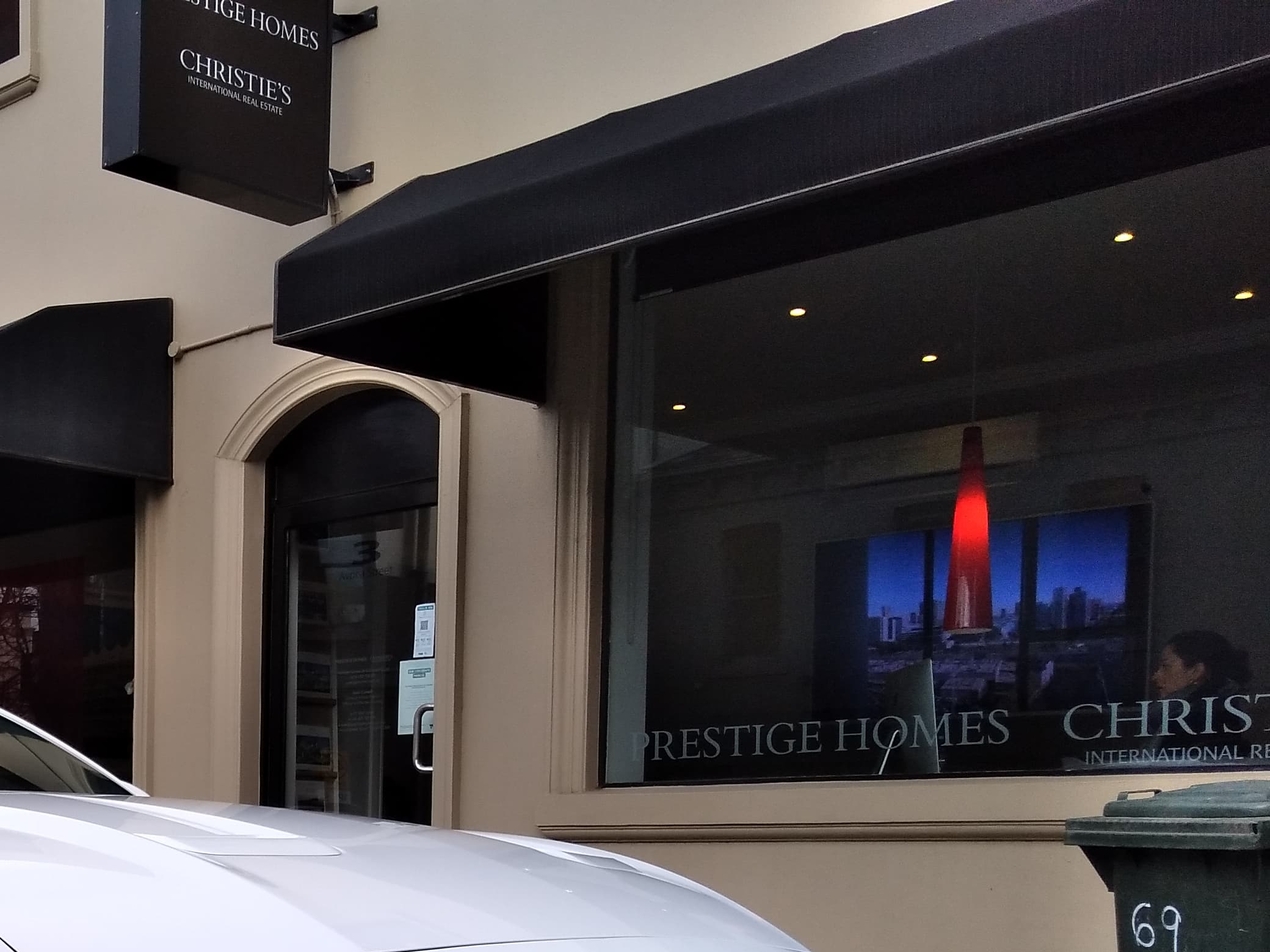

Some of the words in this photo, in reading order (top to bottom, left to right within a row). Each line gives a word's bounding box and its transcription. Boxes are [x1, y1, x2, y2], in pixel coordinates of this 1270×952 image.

[249, 8, 320, 51] HOMES
[180, 48, 293, 106] CHRISTIE'S
[187, 75, 242, 102] INTERNATIONAL
[242, 94, 260, 108] REAL
[260, 102, 283, 116] ESTATE
[629, 720, 823, 762] PRESTIGE
[834, 708, 1011, 753] HOMES
[1084, 744, 1244, 766] INTERNATIONAL
